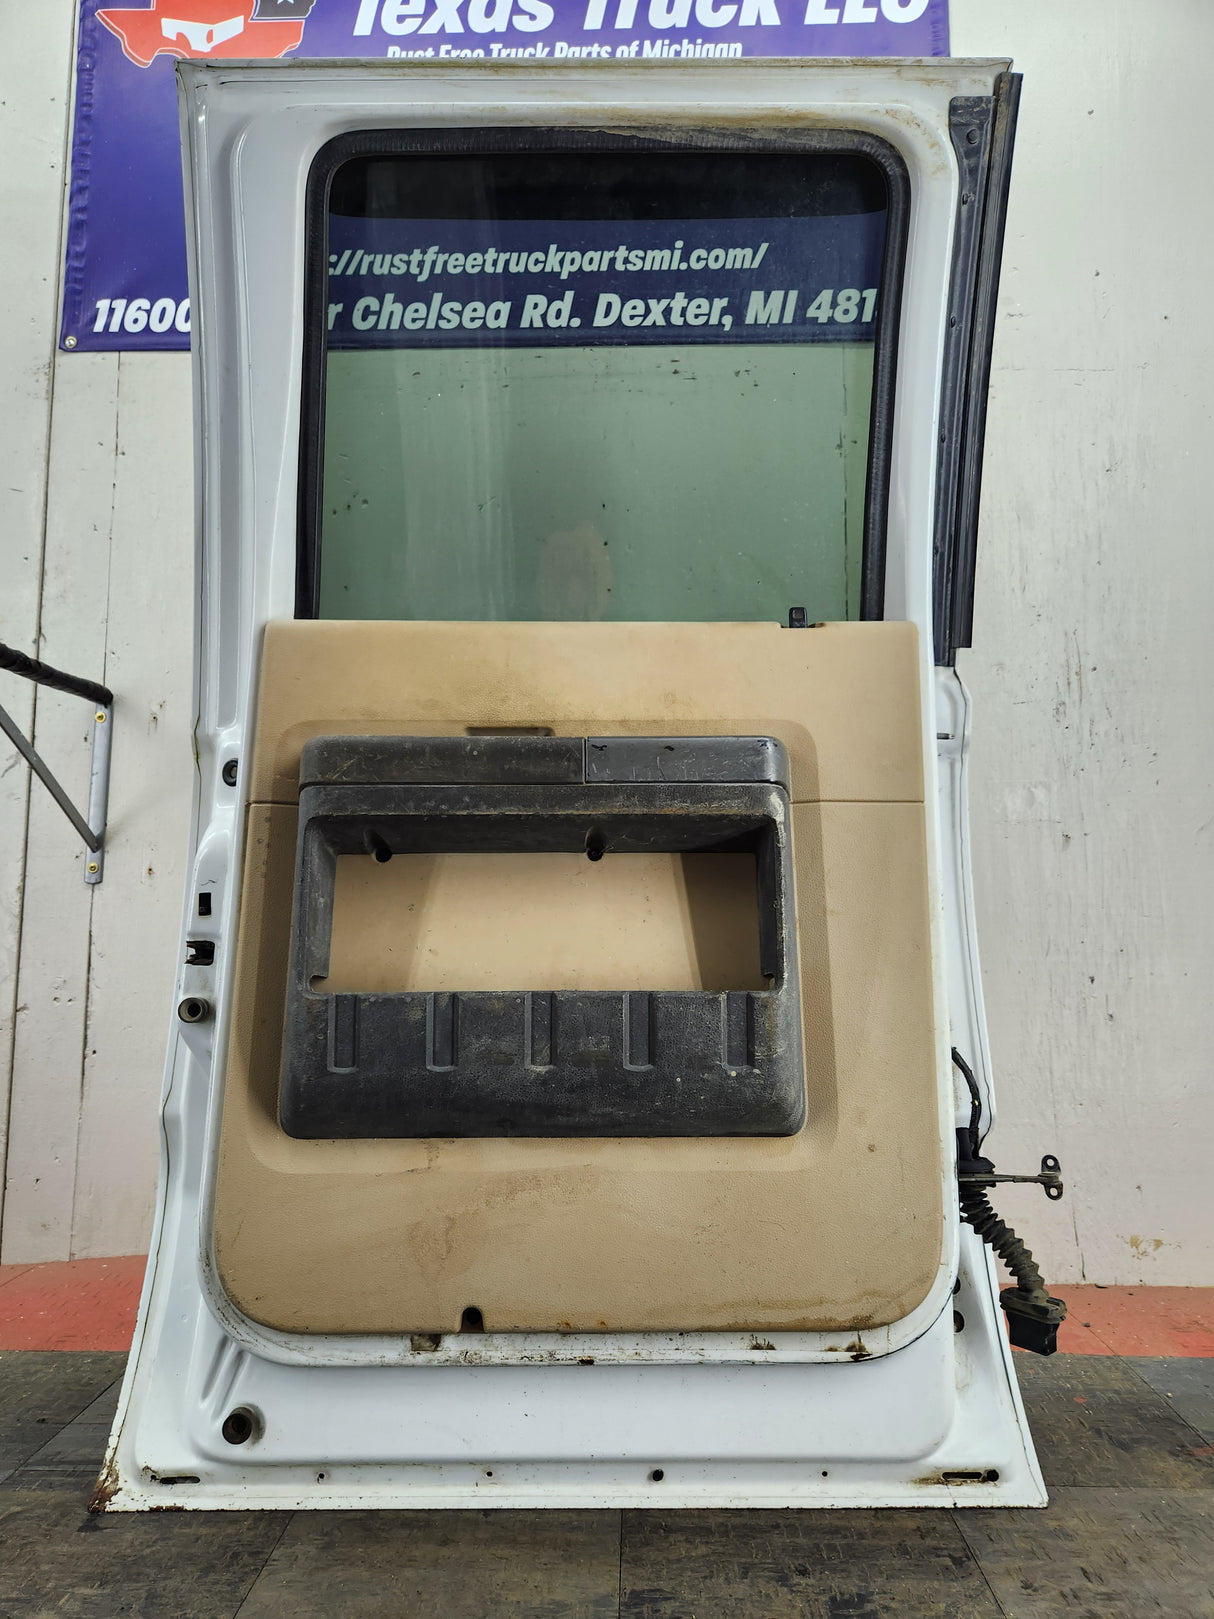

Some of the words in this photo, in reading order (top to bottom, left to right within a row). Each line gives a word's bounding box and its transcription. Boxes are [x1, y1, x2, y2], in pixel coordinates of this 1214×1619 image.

[351, 292, 512, 331] Chelsea
[519, 290, 582, 329] Rd.
[592, 292, 733, 331] Dexter,
[744, 289, 799, 325] MI
[805, 288, 878, 324] 481
